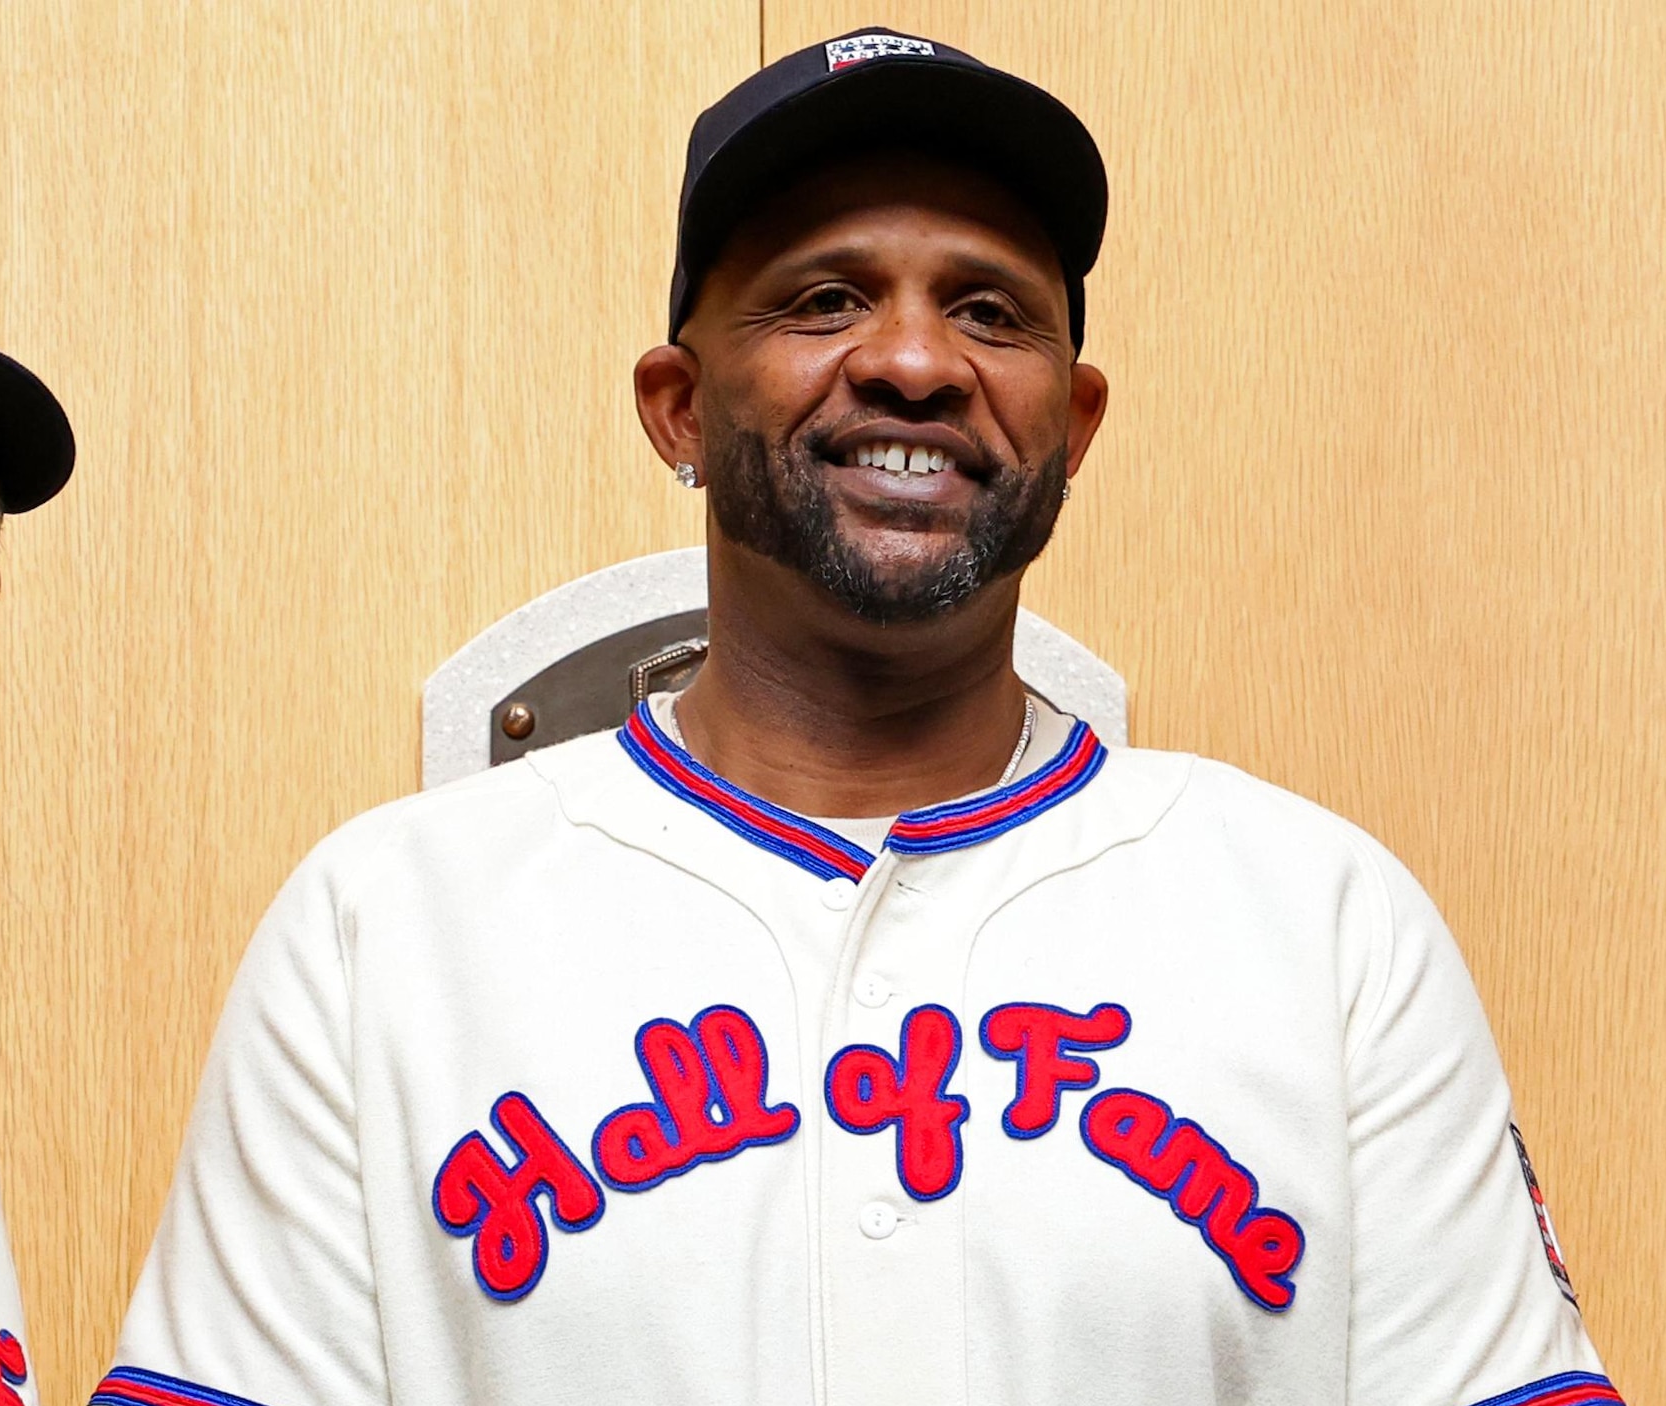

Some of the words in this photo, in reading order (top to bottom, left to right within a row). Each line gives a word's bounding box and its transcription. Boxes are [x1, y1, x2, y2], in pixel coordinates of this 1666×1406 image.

[433, 1003, 801, 1301] Hall
[824, 1003, 972, 1201] of
[978, 1001, 1307, 1314] Fame
